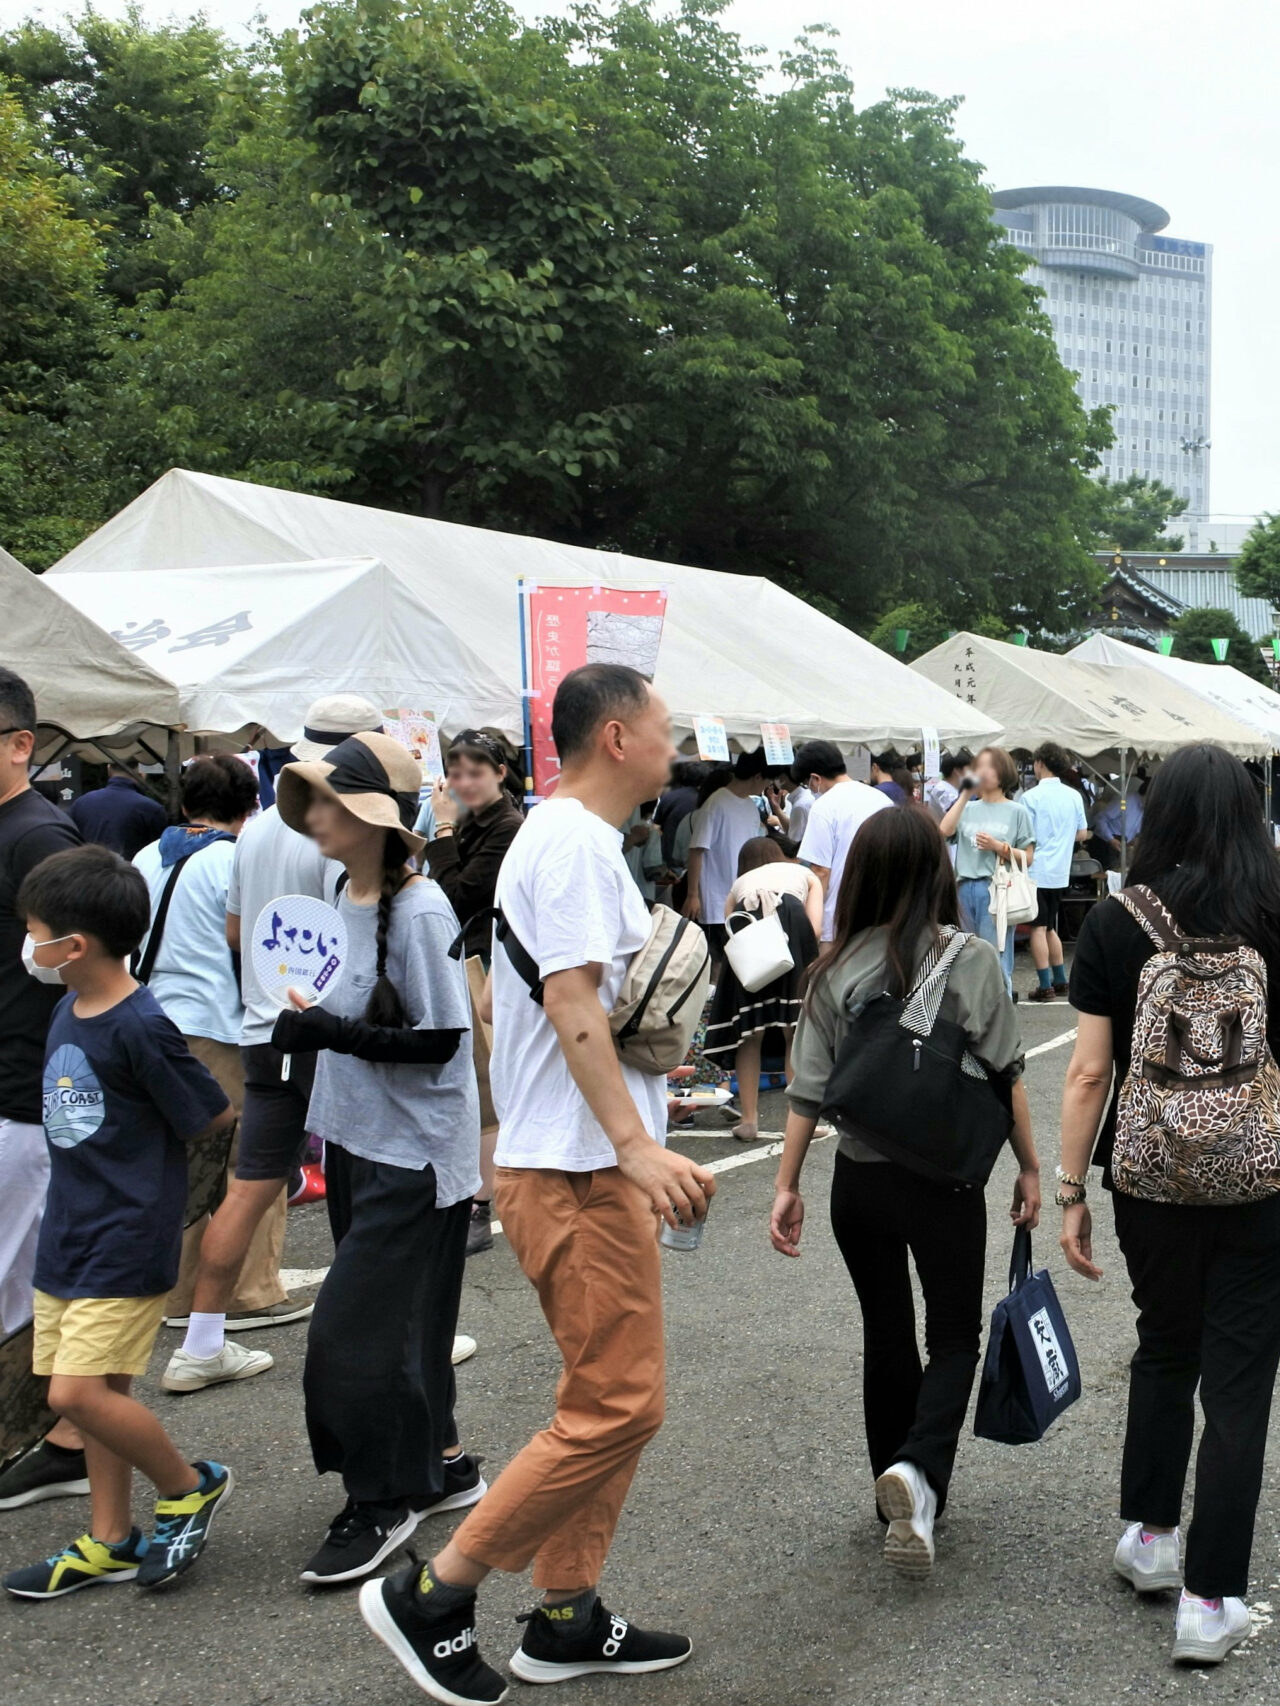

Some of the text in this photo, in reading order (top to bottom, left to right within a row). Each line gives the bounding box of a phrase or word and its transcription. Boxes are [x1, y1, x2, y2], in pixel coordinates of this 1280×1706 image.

[262, 911, 338, 957] よさこい
[61, 1090, 99, 1105] COAST
